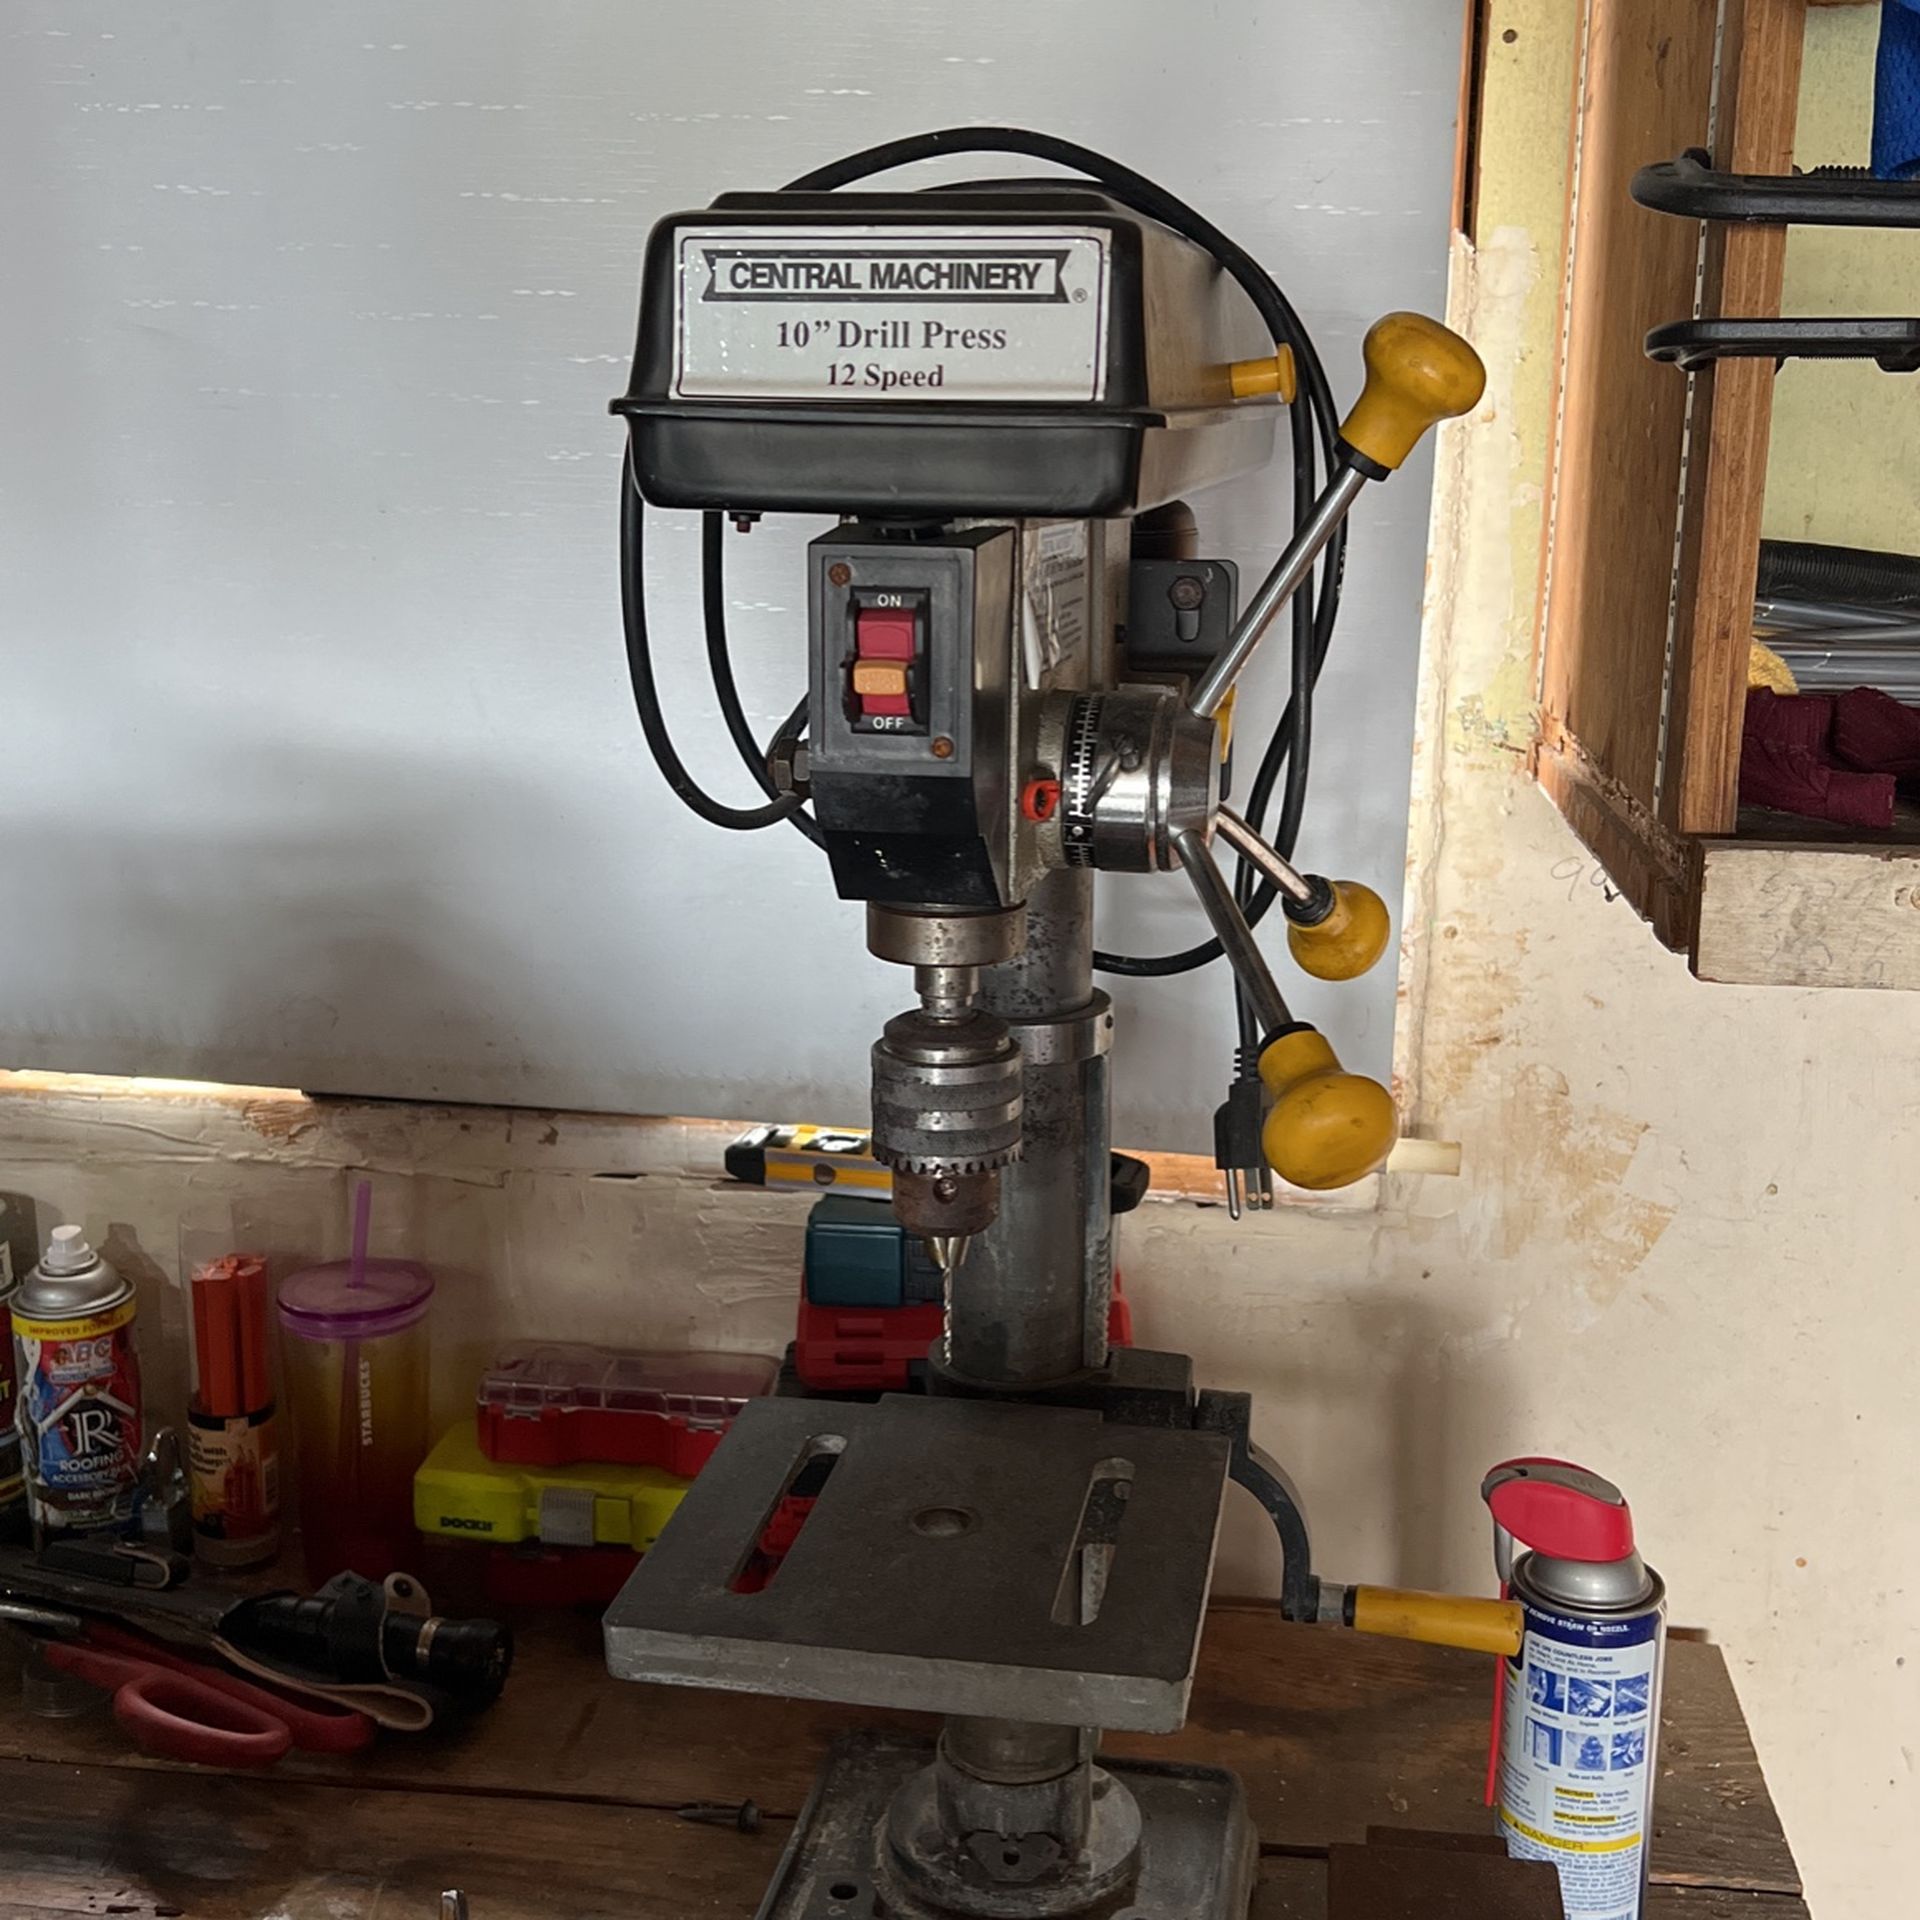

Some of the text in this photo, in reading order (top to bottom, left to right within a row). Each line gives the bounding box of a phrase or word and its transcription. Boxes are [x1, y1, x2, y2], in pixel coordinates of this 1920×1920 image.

[729, 262, 1042, 290] CENTRAL MACHINERY
[837, 320, 910, 348] Drill
[922, 320, 1007, 349] Press
[828, 363, 944, 391] 12 Speed
[877, 594, 902, 607] ON
[872, 716, 905, 730] OFF
[359, 1358, 374, 1446] STARBUCKS
[59, 1448, 125, 1472] ROOFING
[1557, 1619, 1585, 1632] STRAW
[1520, 1823, 1584, 1851] DANGER
